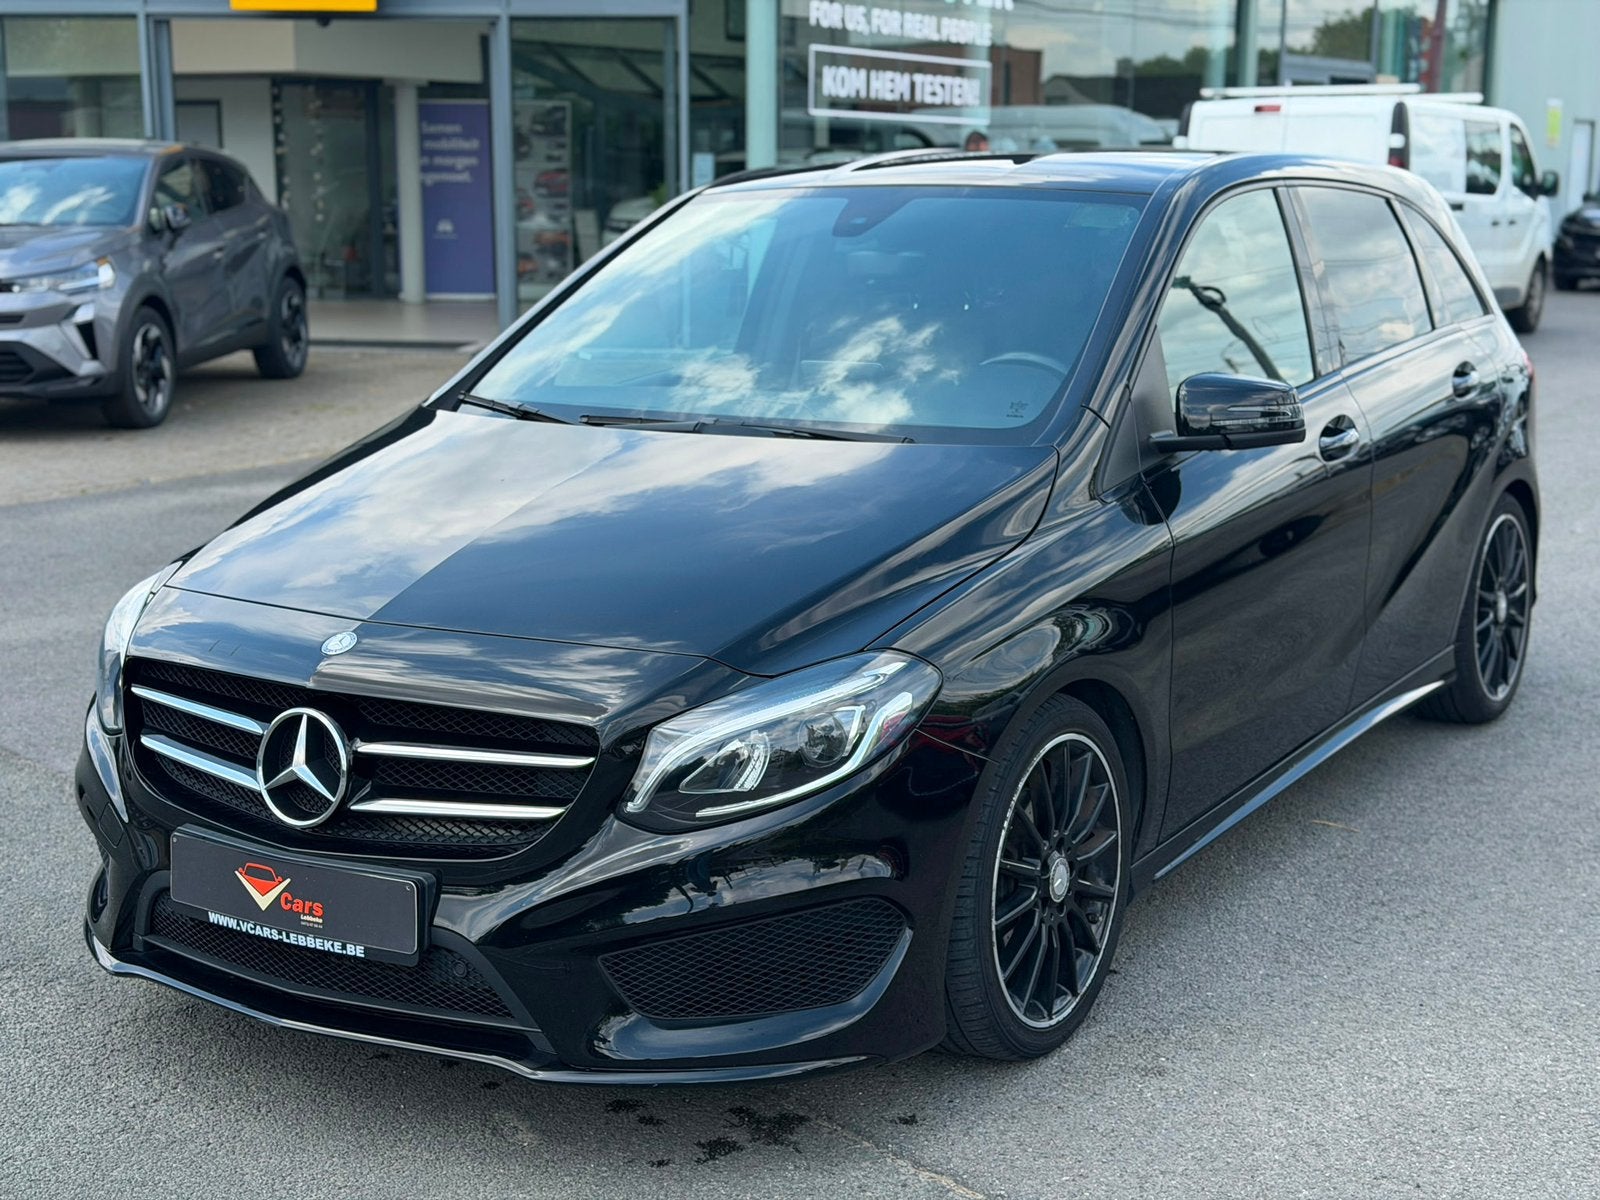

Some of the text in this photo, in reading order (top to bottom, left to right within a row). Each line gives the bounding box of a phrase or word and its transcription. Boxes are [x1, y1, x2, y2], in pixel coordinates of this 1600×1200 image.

[808, 0, 843, 30] FOR
[871, 8, 902, 36] FOR
[903, 12, 940, 41] REAL
[941, 17, 992, 47] PEOPLE
[822, 65, 981, 106] KOM HEM TESTEN!
[281, 892, 324, 916] Cars
[207, 911, 366, 958] WWW.VCARS-LEBBEKE.BE
